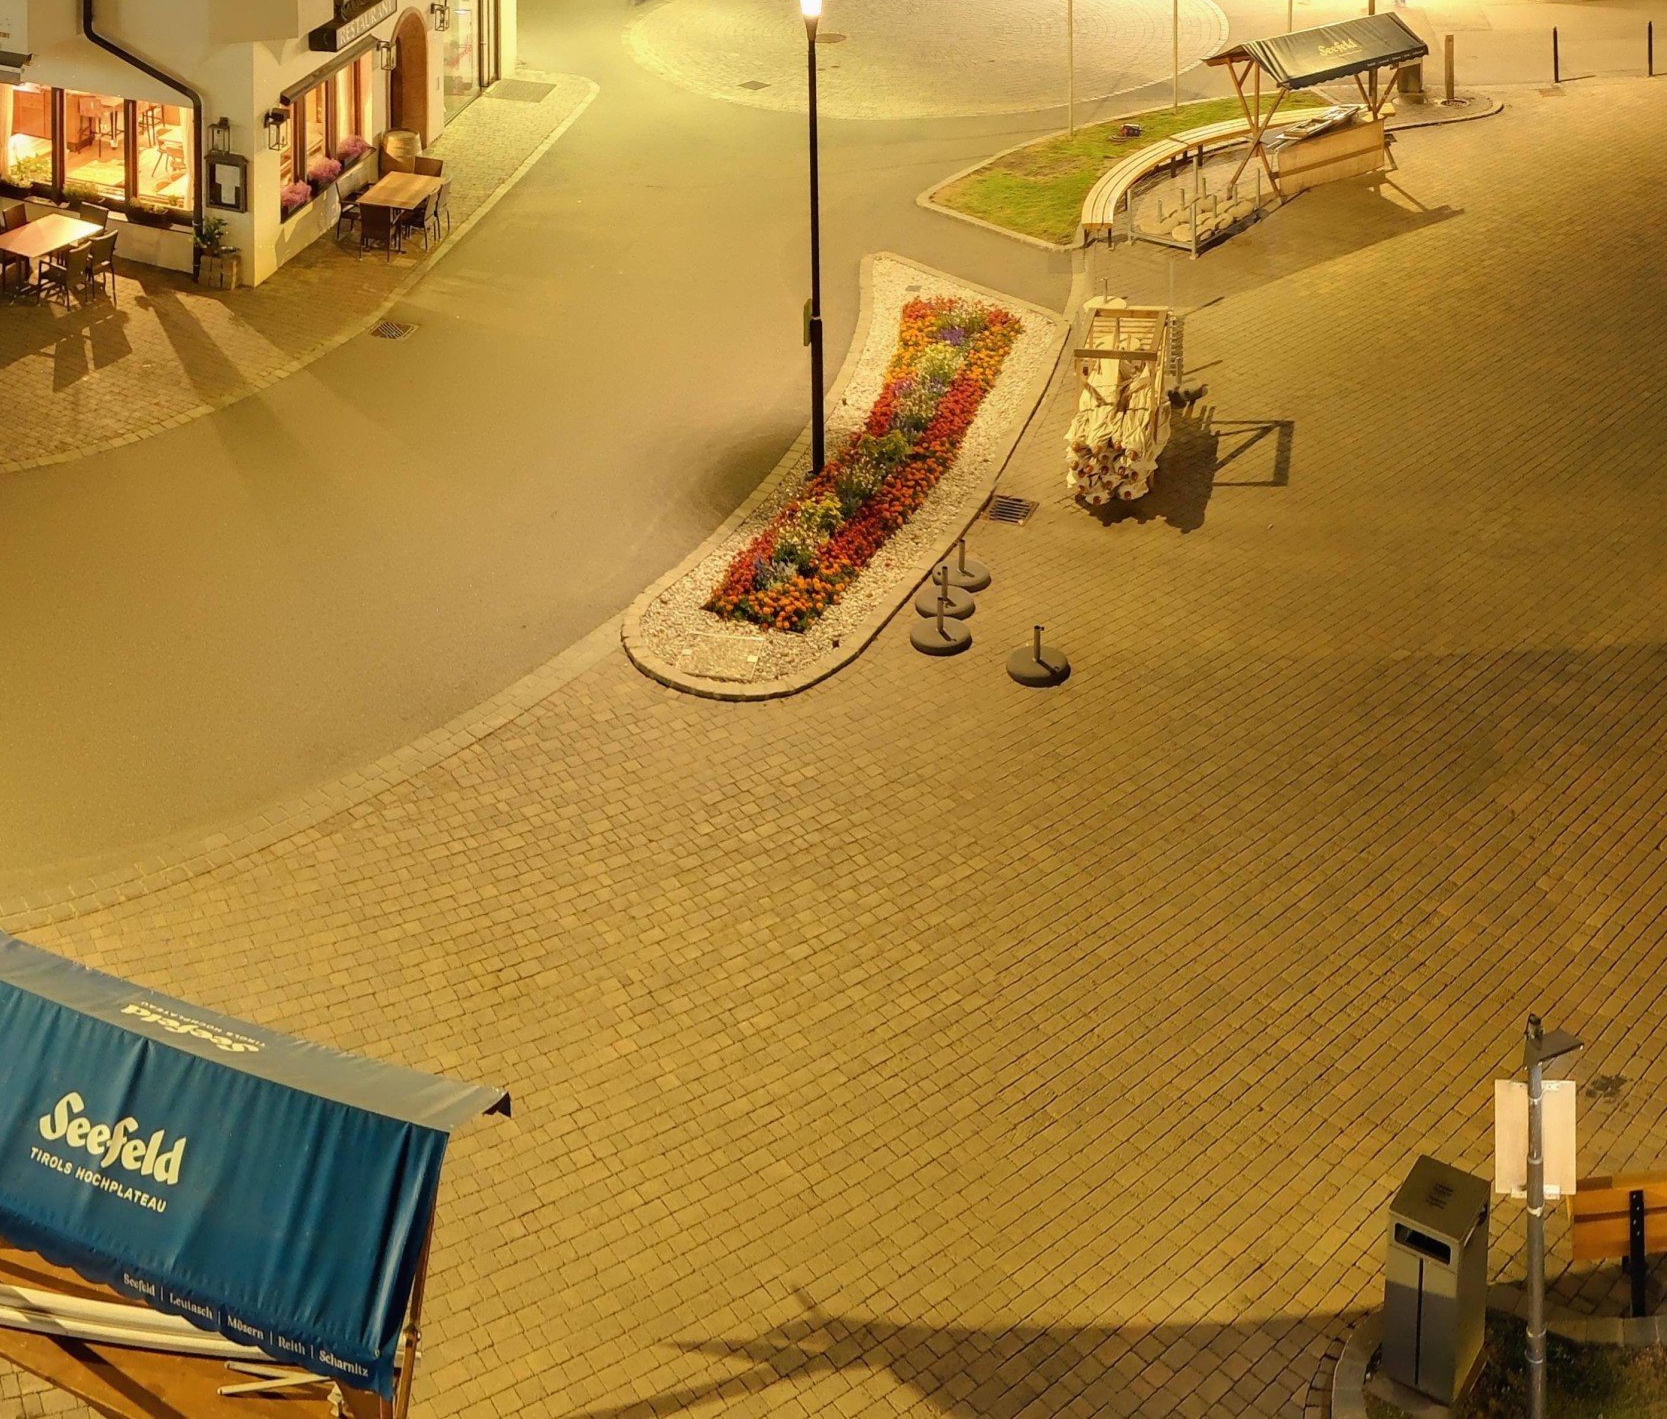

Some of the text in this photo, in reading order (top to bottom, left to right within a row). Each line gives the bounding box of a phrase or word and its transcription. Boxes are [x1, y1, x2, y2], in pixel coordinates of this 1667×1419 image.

[340, 0, 392, 44] RESTAURANT
[1318, 38, 1358, 57] Seefeld
[120, 1003, 260, 1052] Seefeld
[39, 1091, 187, 1185] Seefeld
[30, 1146, 167, 1213] TIROLS HOCHPLATEAU
[123, 1272, 369, 1378] Seefeld Leutasch Mösern Reith Scharnitz
